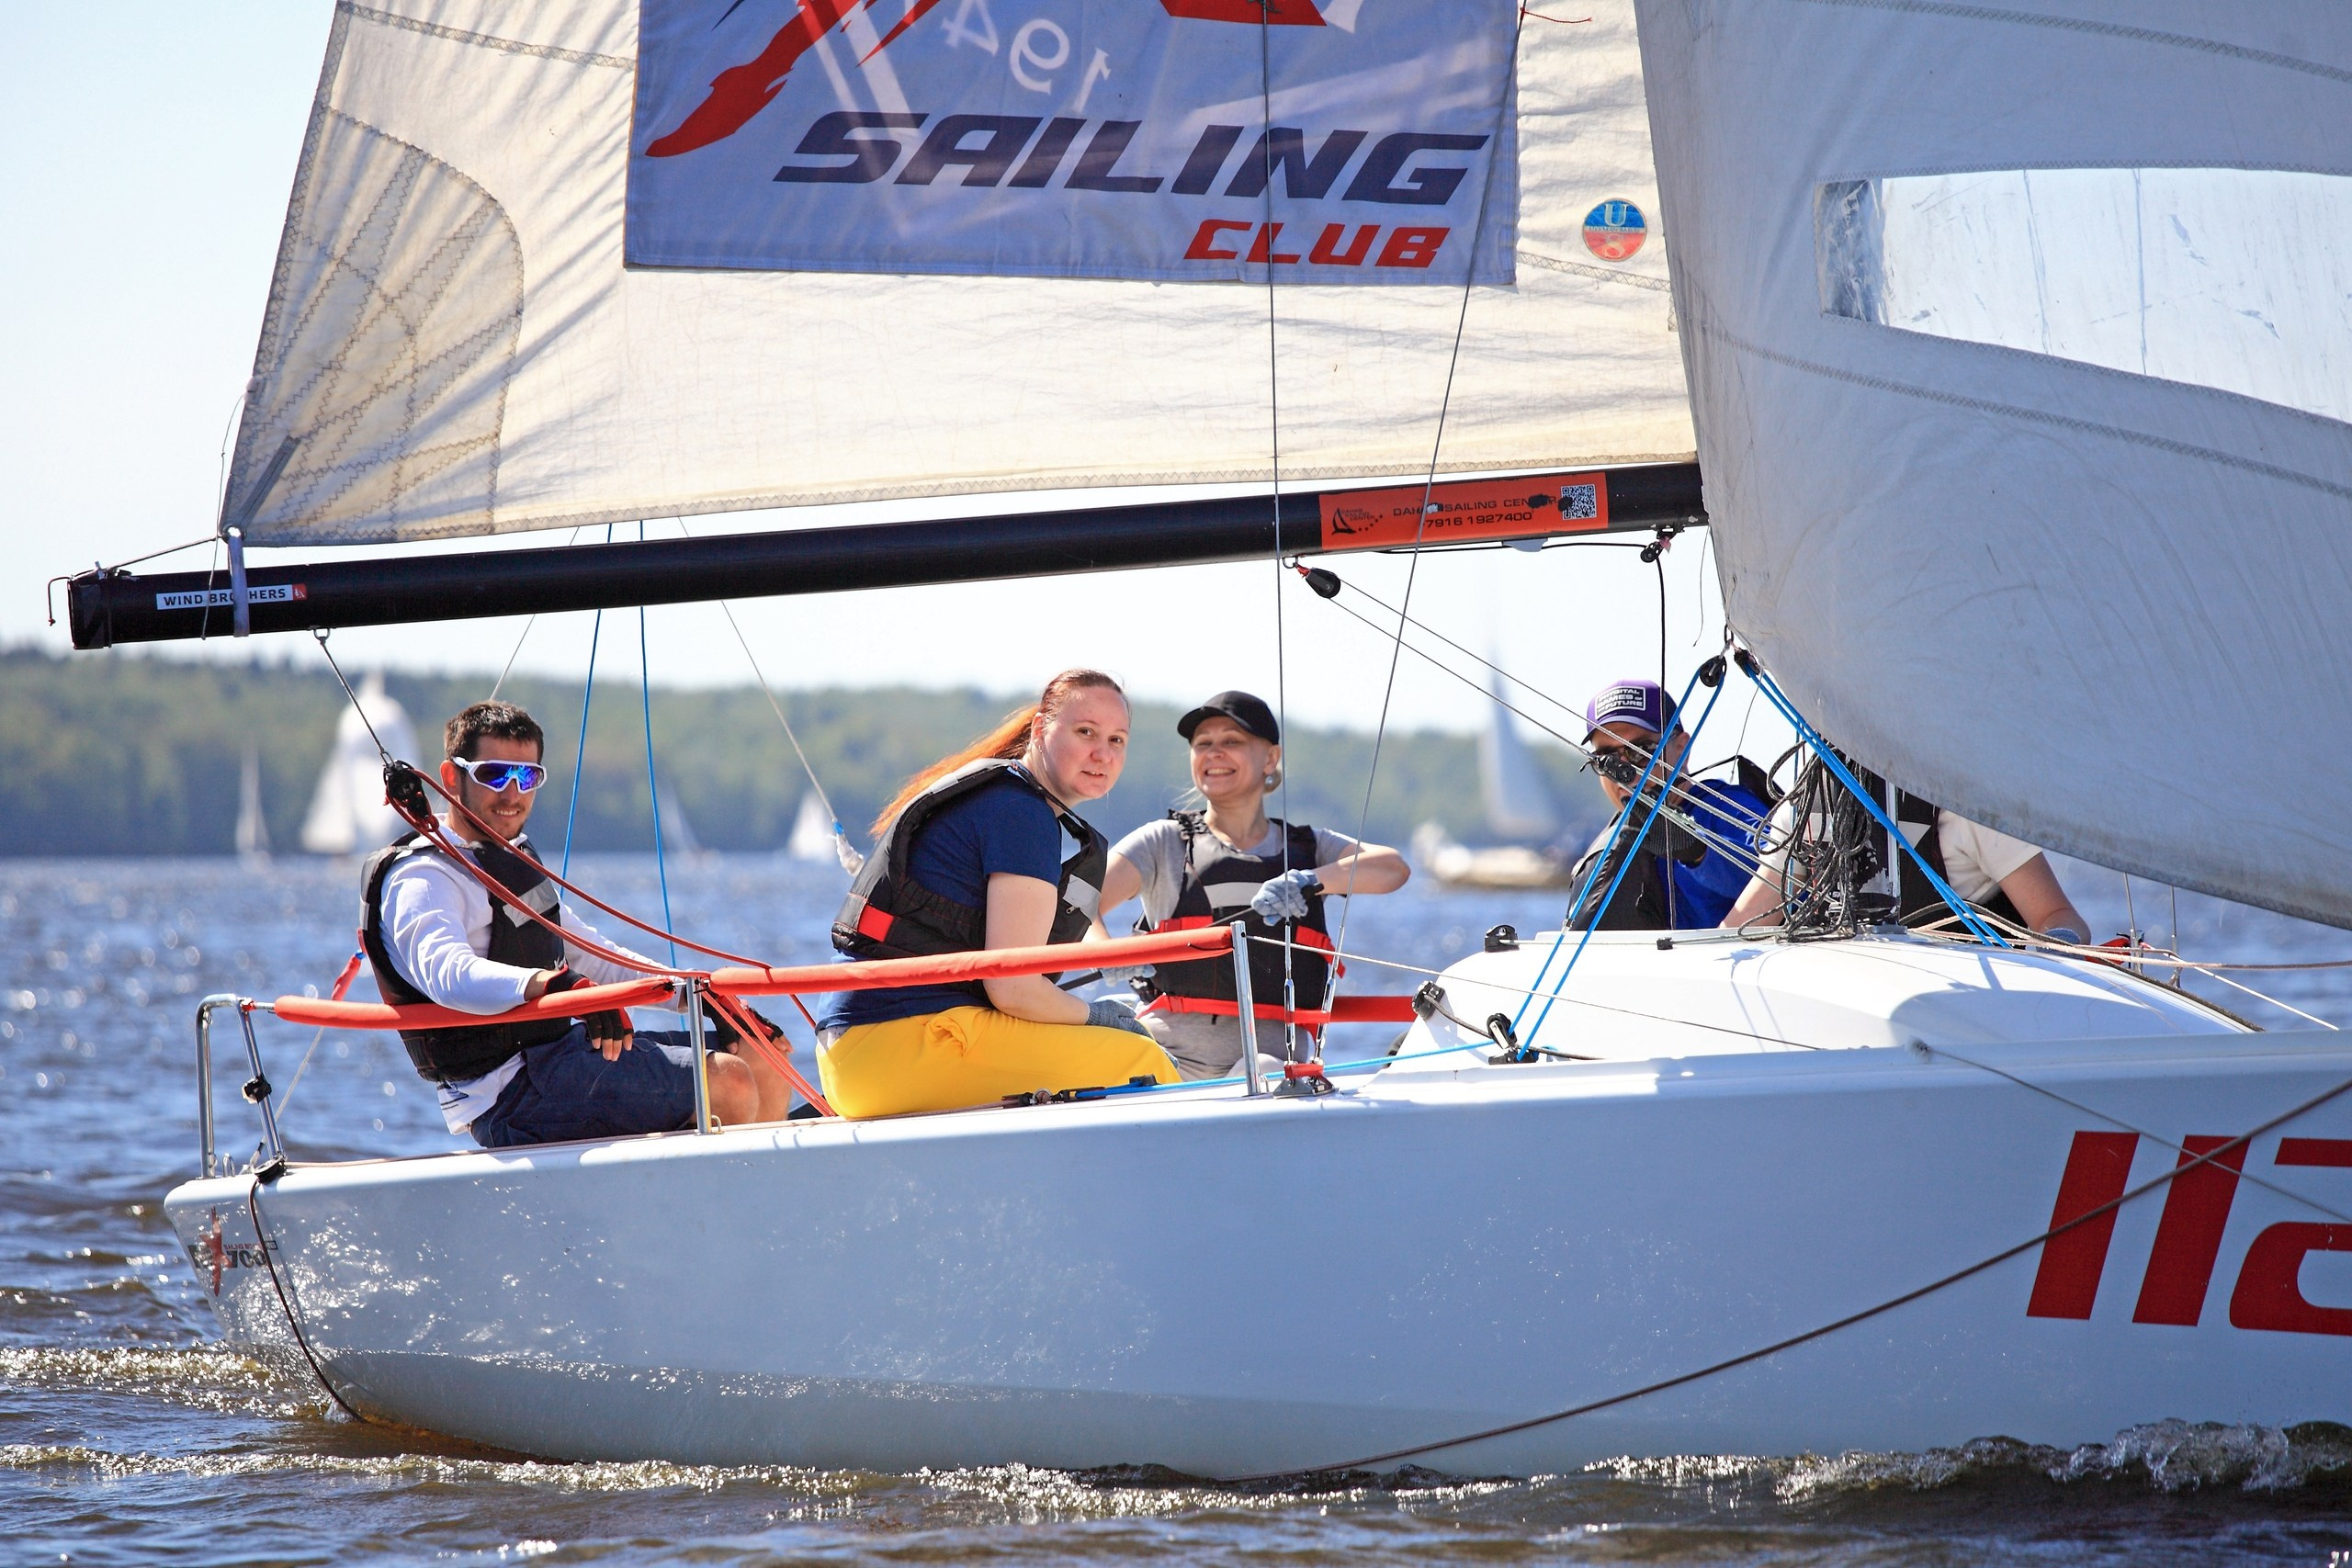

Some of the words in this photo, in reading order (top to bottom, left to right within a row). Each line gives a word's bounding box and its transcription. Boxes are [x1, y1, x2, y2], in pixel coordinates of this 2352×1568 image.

[773, 110, 1489, 205] SAILING
[1183, 219, 1450, 267] CLUB
[1393, 502, 1443, 516] DAH
[1444, 501, 1498, 512] SAILING
[1503, 496, 1557, 507] CENR
[1422, 517, 1463, 528] 7916
[1467, 512, 1532, 525] 1927400
[164, 594, 203, 606] WIND
[209, 588, 286, 604] BRHERS
[1605, 700, 1643, 710] FUTURE
